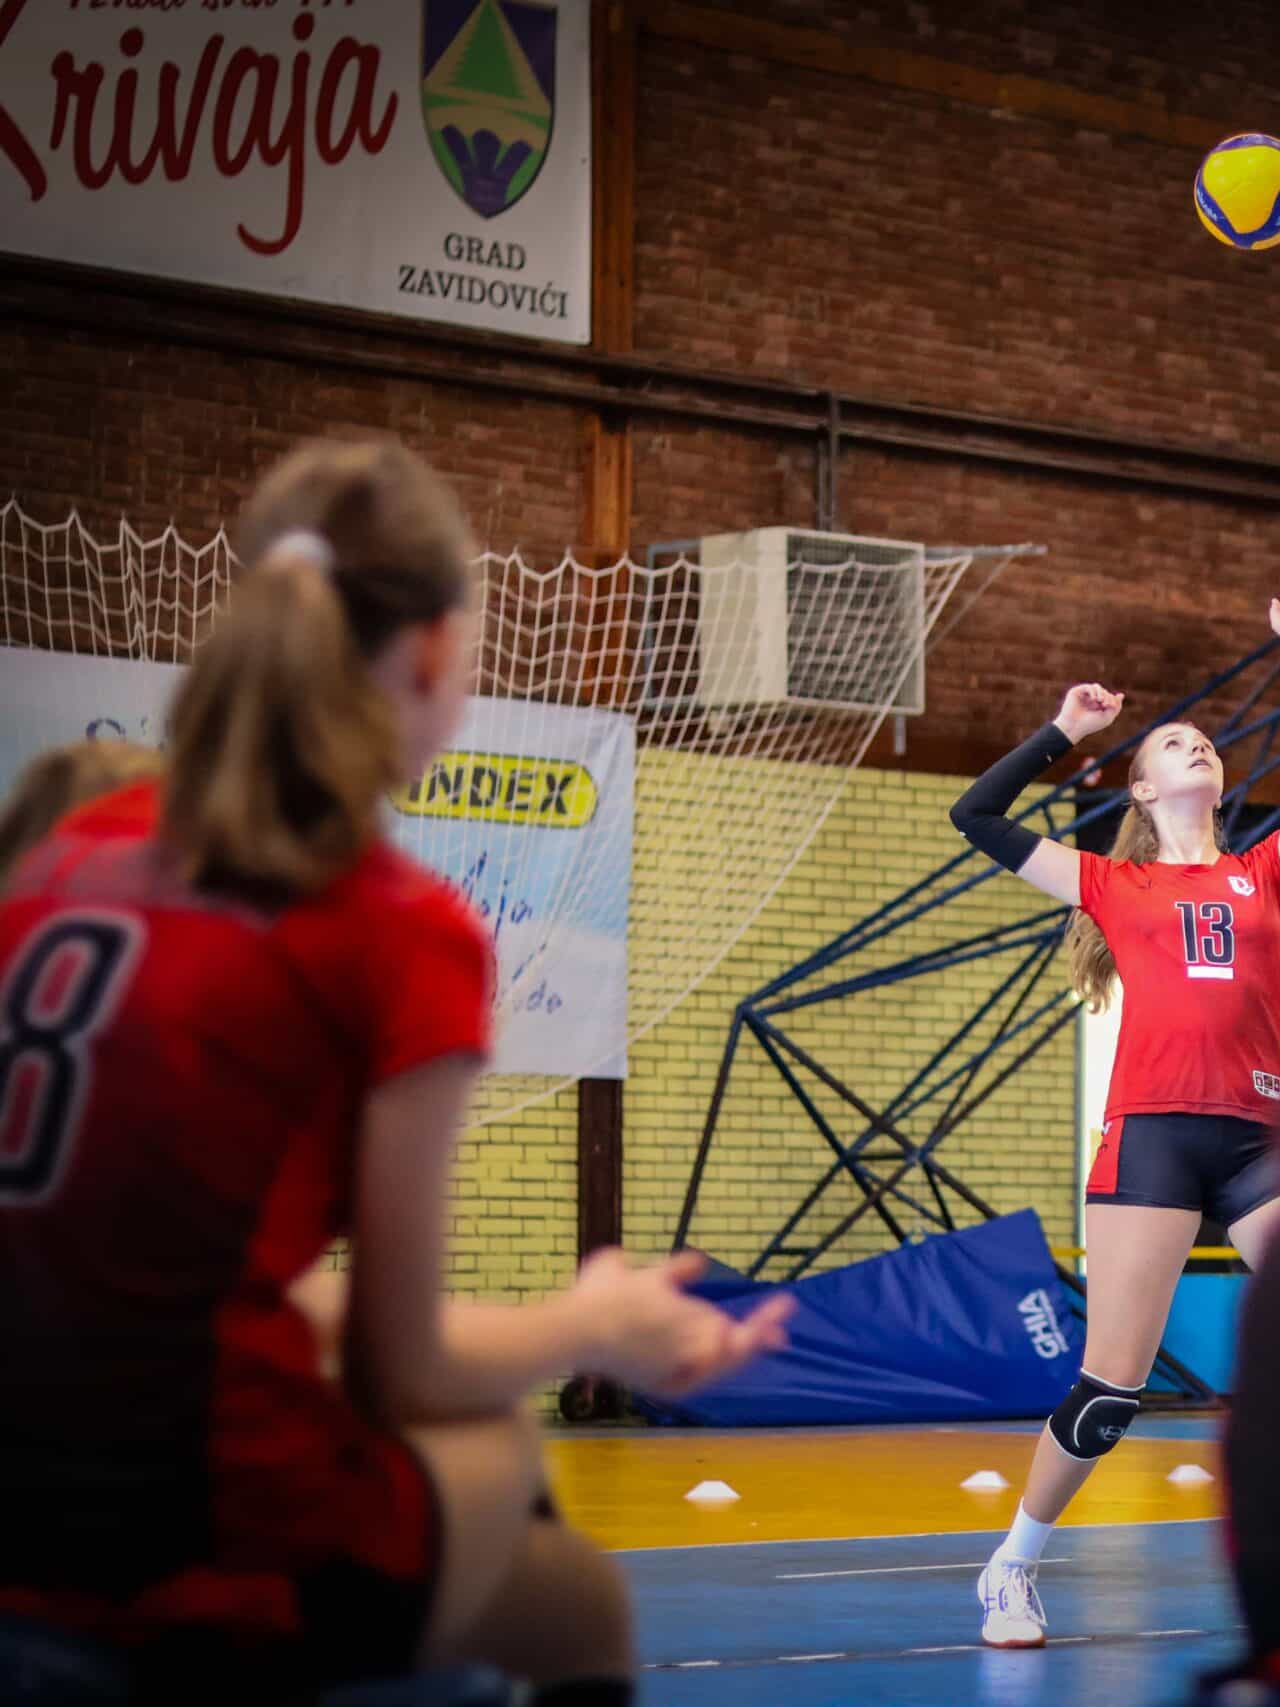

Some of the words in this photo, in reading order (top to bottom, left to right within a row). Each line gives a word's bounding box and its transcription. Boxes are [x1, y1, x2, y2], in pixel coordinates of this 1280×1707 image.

[443, 232, 527, 271] GRAD
[398, 264, 568, 318] ZAVIDOVIĆI
[1174, 901, 1235, 966] 13
[0, 906, 147, 1208] 8
[1018, 1290, 1060, 1359] GHIA
